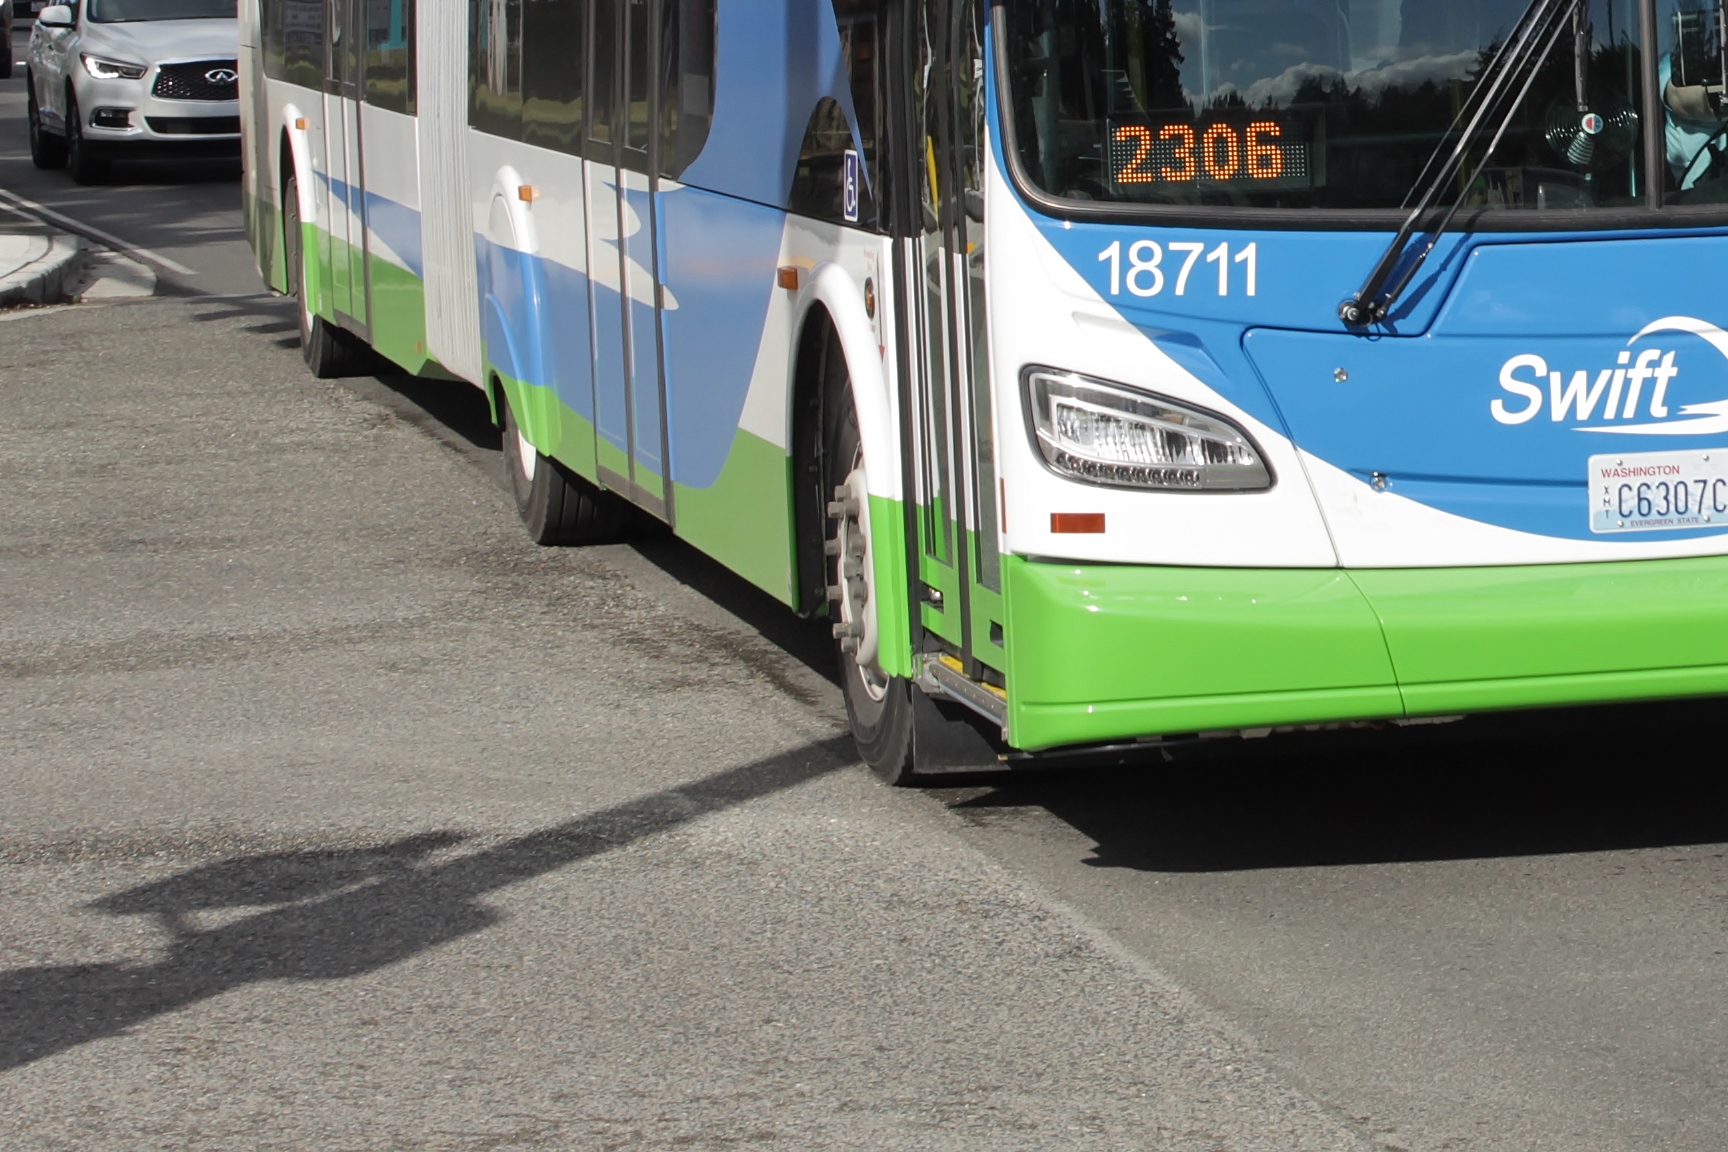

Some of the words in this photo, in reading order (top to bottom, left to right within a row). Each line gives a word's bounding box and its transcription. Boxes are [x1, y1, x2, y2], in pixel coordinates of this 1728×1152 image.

[1115, 122, 1284, 183] 2306
[1098, 239, 1257, 297] 18711
[1490, 348, 1679, 425] Swift
[1601, 465, 1680, 478] WASHINGTON
[1618, 478, 1728, 518] C6307C
[1630, 518, 1674, 527] EVERGREEN
[1677, 516, 1700, 525] STATE
